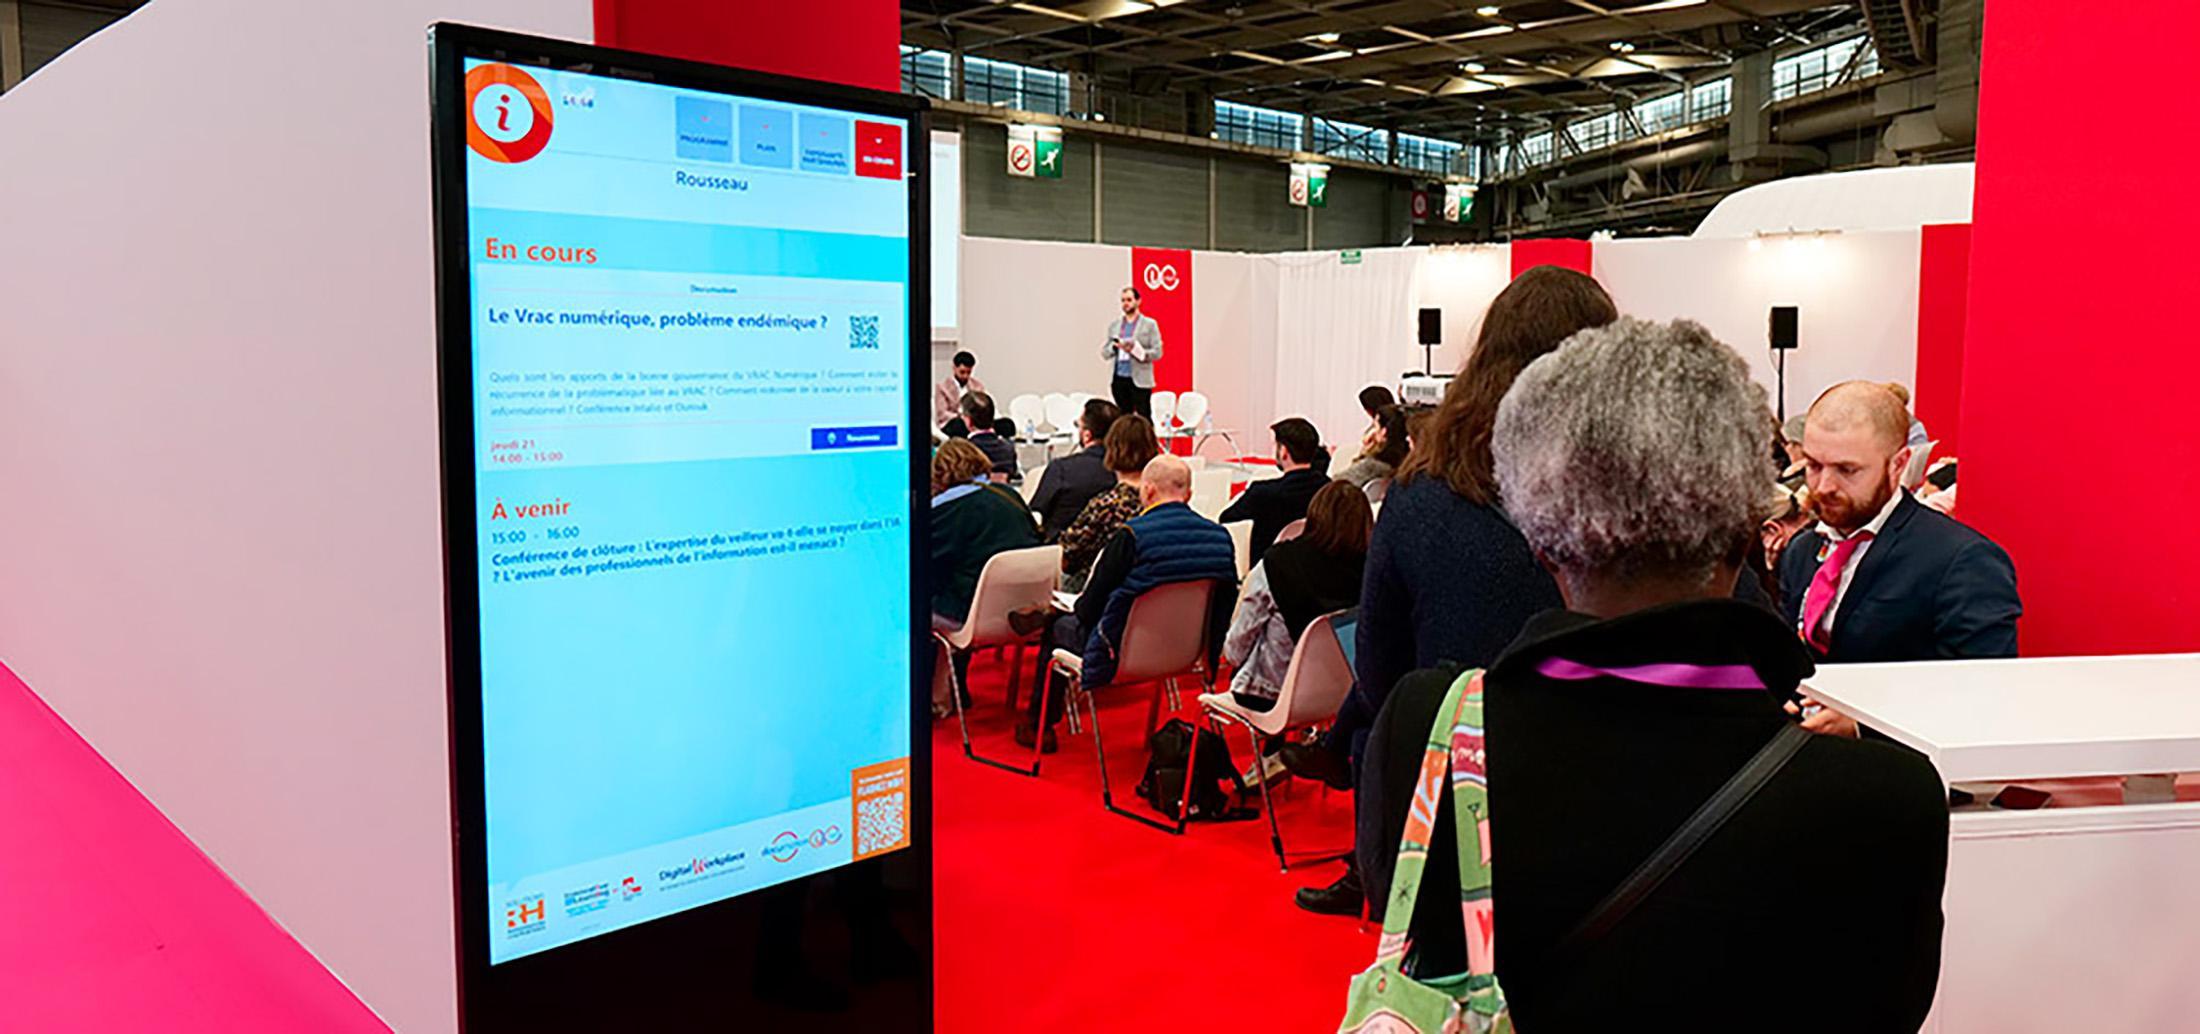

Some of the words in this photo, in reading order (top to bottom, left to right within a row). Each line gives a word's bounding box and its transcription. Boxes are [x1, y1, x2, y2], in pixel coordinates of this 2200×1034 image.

[676, 170, 749, 192] Rousseau
[486, 238, 518, 261] En
[527, 241, 598, 265] cours
[489, 308, 510, 323] Le
[515, 309, 555, 324] Vrac
[559, 310, 656, 328] numérique,
[660, 312, 734, 330] problème
[738, 314, 818, 331] endémique
[821, 315, 828, 329] ?
[525, 373, 546, 382] sont
[551, 372, 565, 382] les
[570, 372, 607, 384] apports
[612, 373, 624, 381] de
[628, 373, 637, 381] la
[549, 389, 561, 397] de
[564, 388, 574, 397] la
[668, 388, 679, 396] au
[664, 403, 673, 412] et
[491, 440, 519, 452] jeudi
[522, 439, 535, 450] 21
[491, 497, 508, 520] À
[514, 497, 571, 519] venir
[492, 549, 569, 567] Conférence
[571, 546, 588, 559] de
[592, 543, 637, 557] clôture
[646, 536, 708, 552] L'expertise
[710, 533, 726, 546] du
[728, 530, 769, 543] veilleur
[816, 525, 828, 535] se
[830, 523, 858, 536] noyer
[860, 517, 882, 530] dans
[493, 571, 500, 583] ?
[503, 566, 557, 582] L'avenir
[560, 563, 583, 577] des
[586, 554, 675, 576] professionnels
[676, 552, 692, 565] de
[693, 545, 768, 562] l'information
[799, 537, 838, 551] menacé
[839, 536, 845, 548] ?
